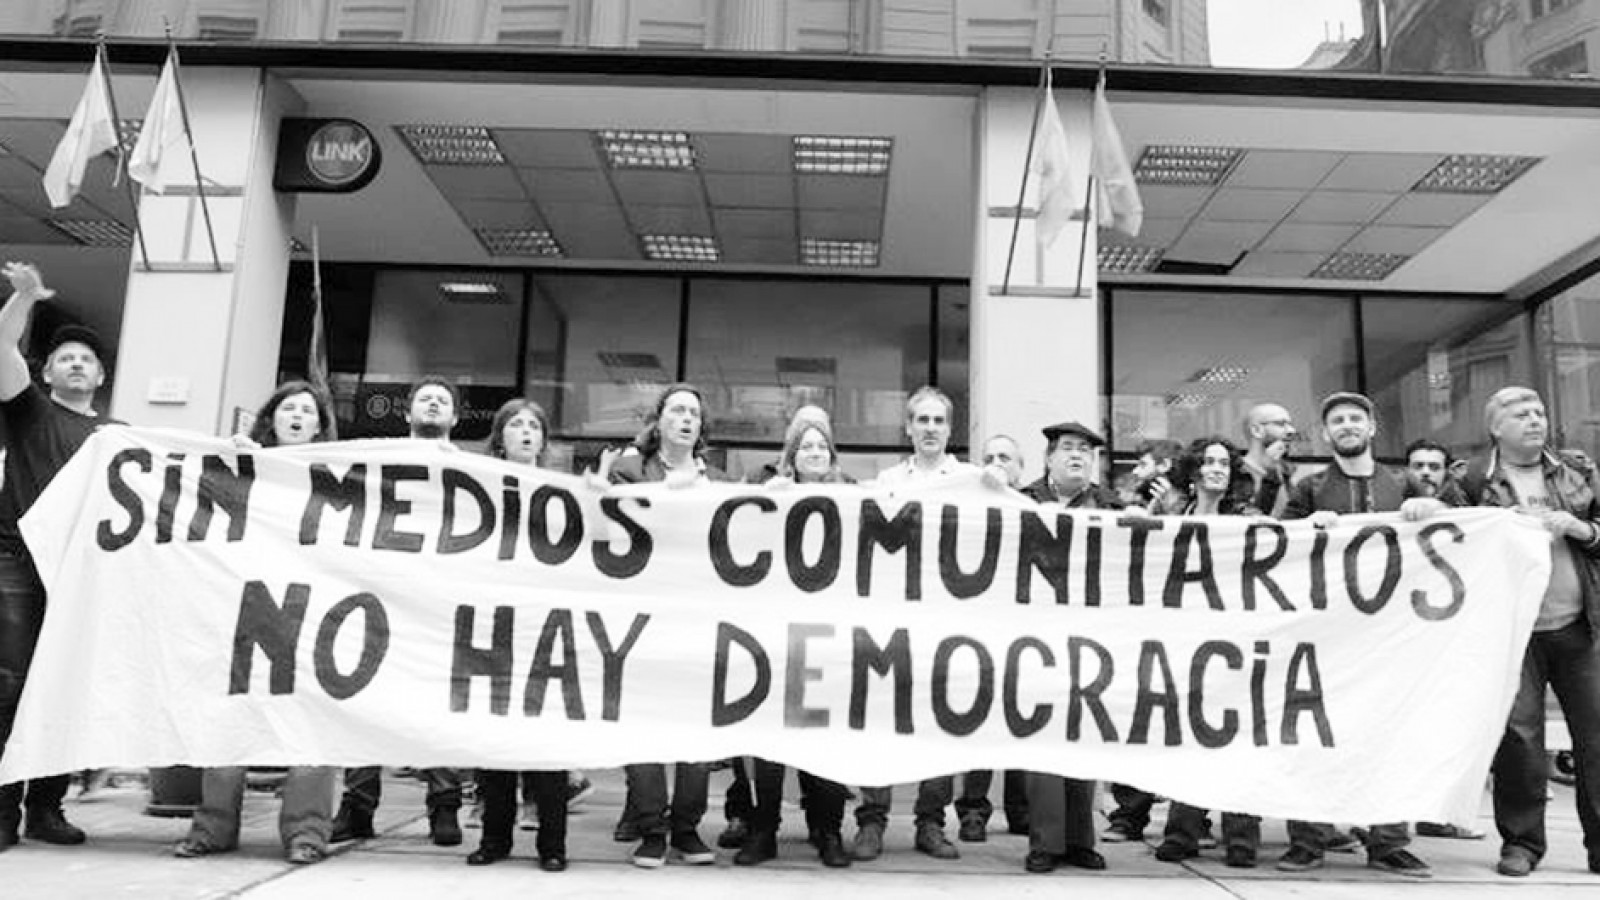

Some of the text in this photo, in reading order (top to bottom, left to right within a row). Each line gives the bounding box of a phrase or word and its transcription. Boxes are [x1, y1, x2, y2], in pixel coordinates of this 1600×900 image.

[312, 136, 370, 161] LINK
[228, 580, 391, 701] NO
[449, 604, 652, 723] HAY
